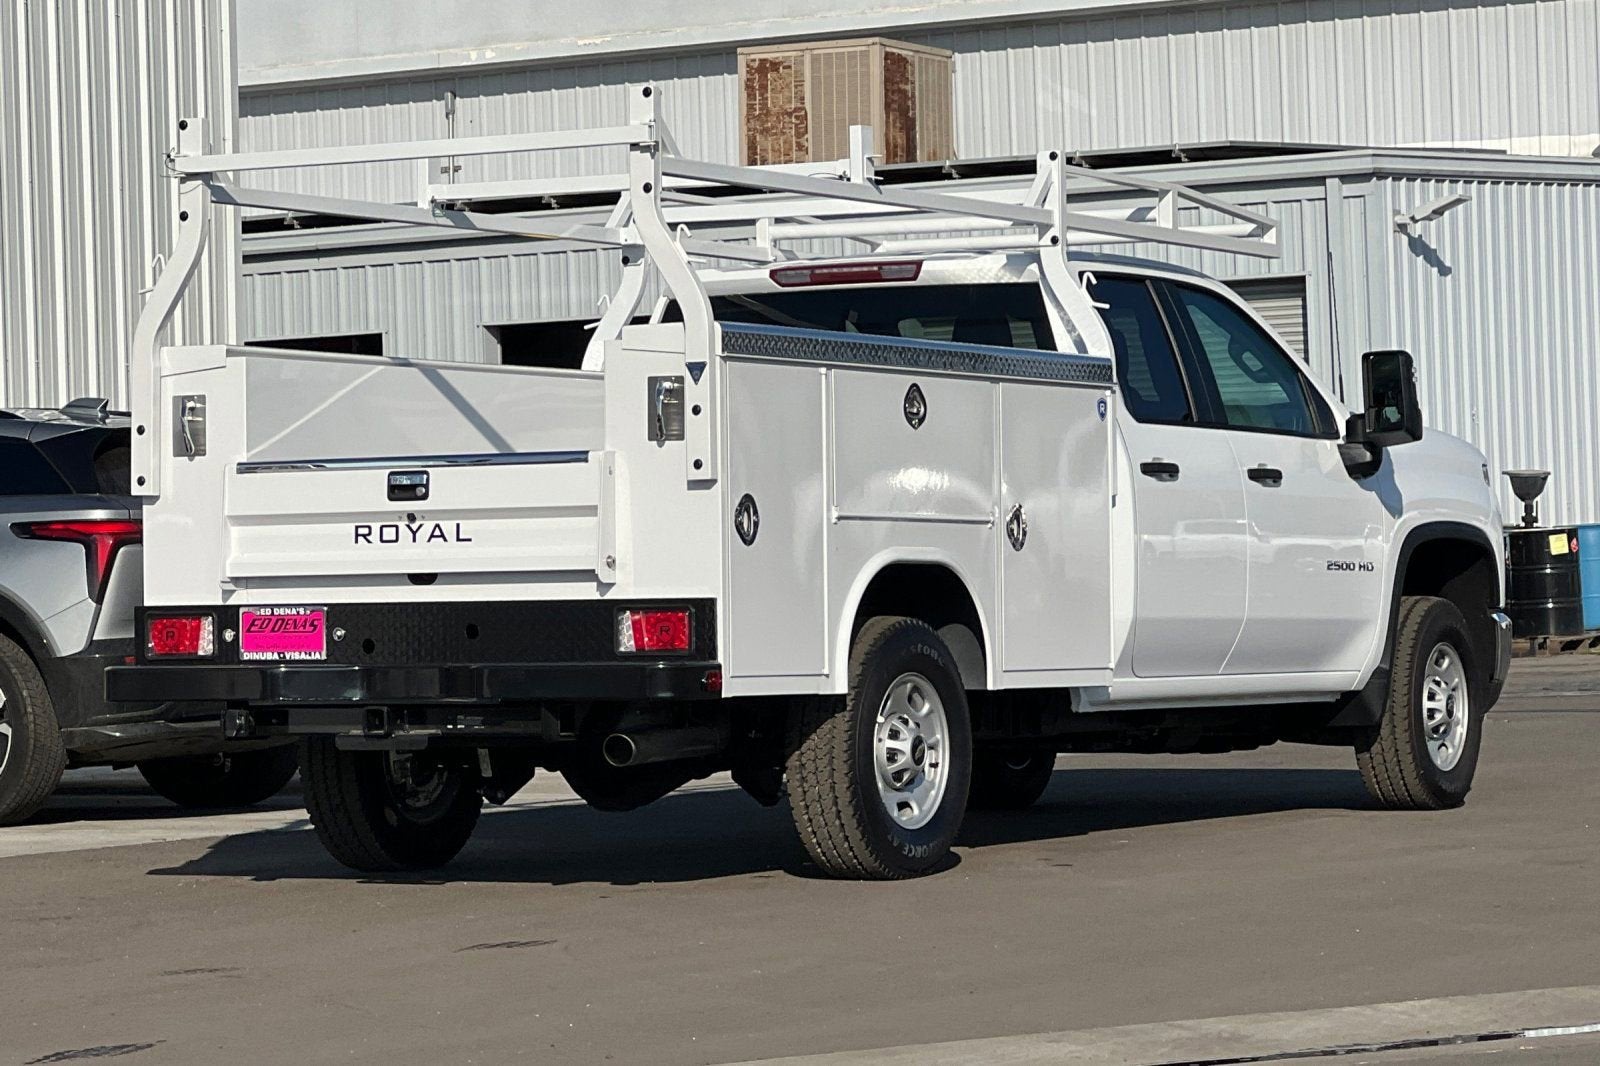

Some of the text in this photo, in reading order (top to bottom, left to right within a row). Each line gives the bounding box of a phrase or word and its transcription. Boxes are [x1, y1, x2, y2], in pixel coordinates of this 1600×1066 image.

[354, 523, 472, 544] ROYAL
[1326, 560, 1374, 571] 2500 HD
[274, 607, 305, 616] DENA'S
[246, 618, 272, 633] ED
[243, 652, 321, 660] DINUBA VISALIA
